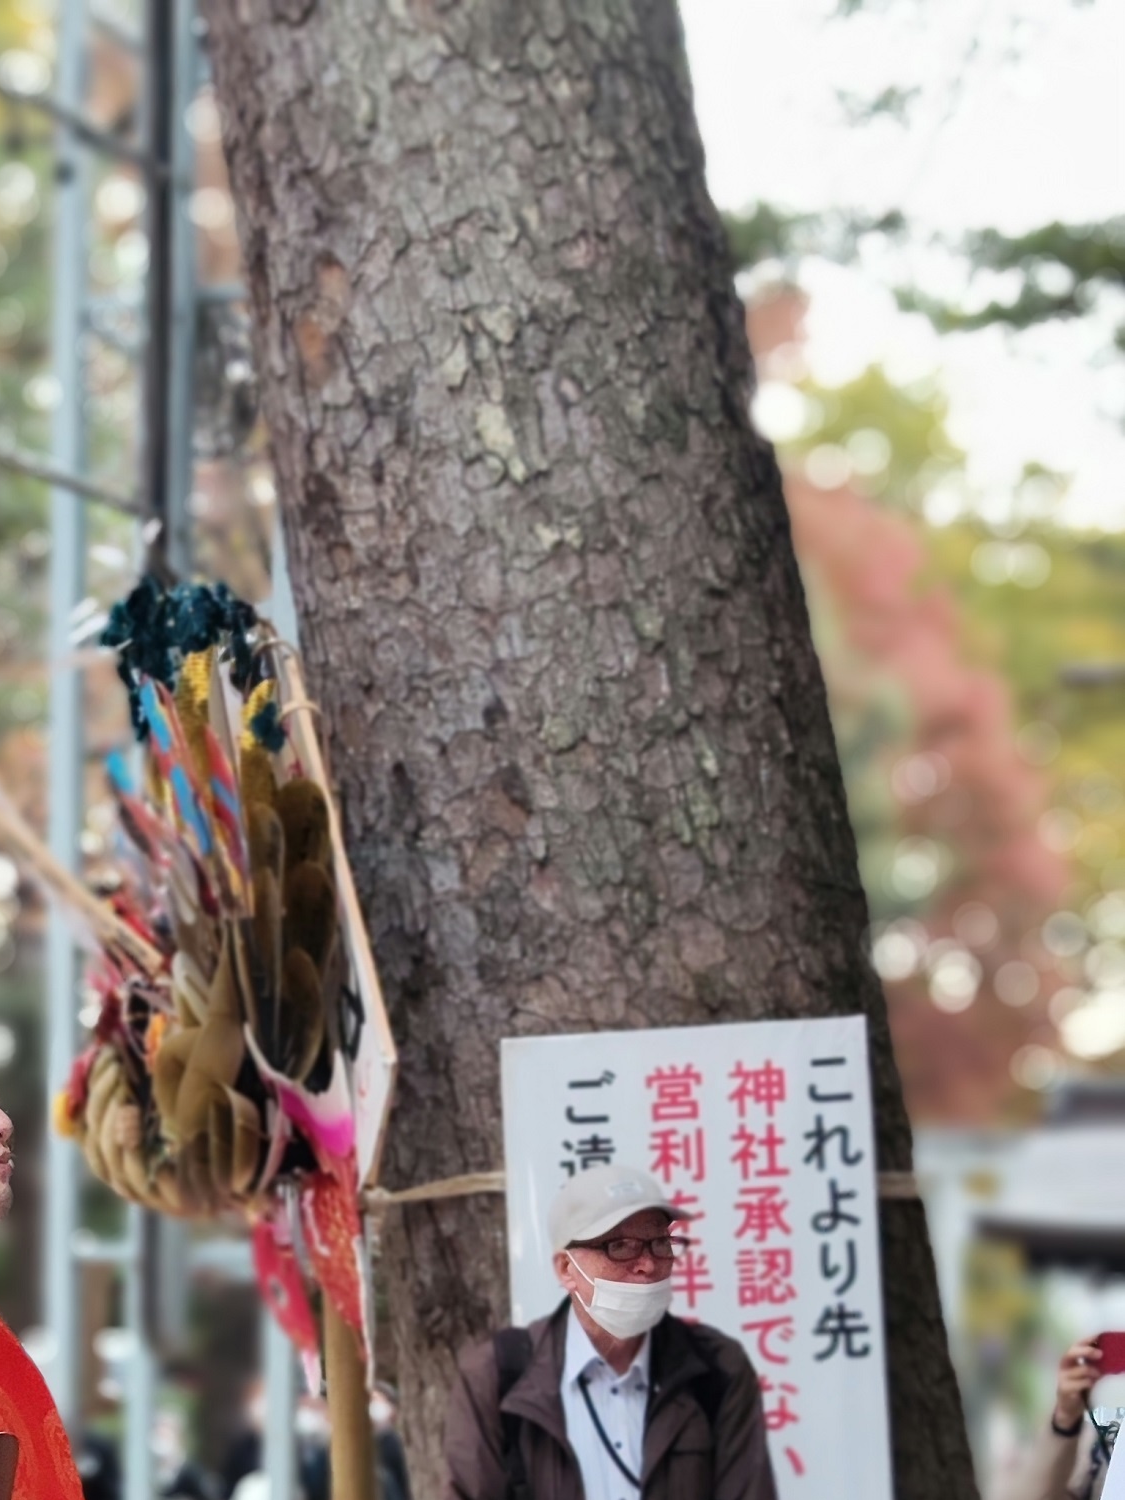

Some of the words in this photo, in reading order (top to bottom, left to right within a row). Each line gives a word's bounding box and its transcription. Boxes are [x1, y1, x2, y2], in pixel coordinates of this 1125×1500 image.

[802, 1054, 871, 1364] これより先
